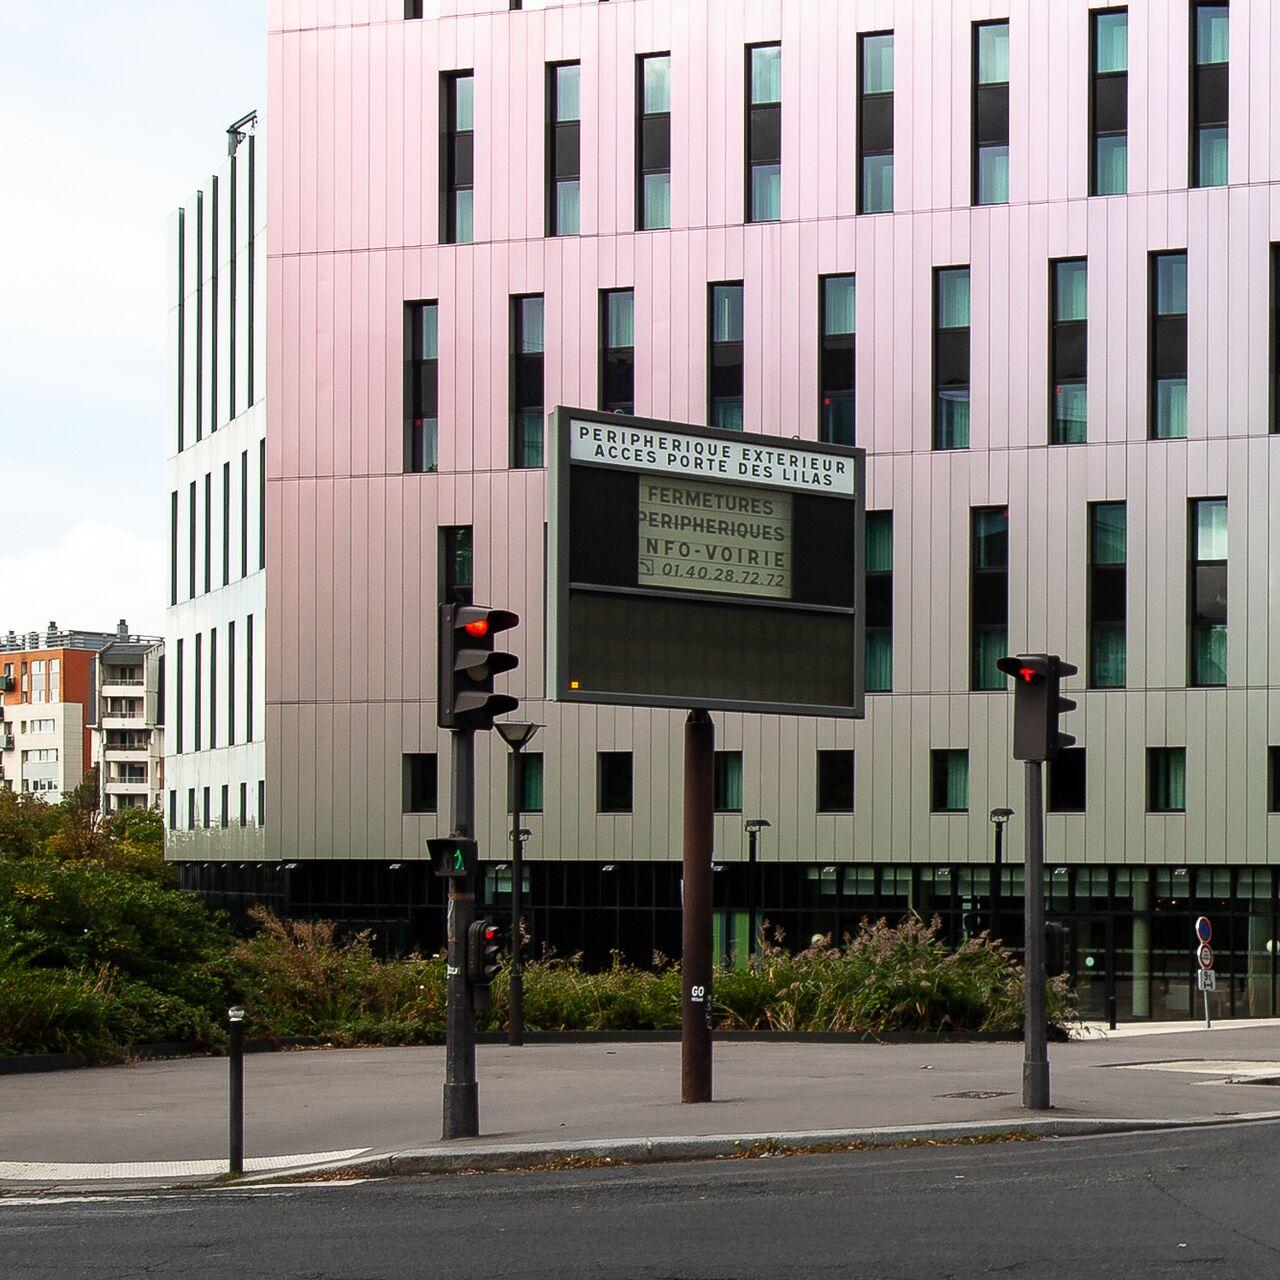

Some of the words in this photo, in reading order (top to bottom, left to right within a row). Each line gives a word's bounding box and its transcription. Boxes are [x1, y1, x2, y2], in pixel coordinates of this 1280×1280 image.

[579, 426, 731, 458] PERIPHERIQUE
[742, 448, 845, 474] EXTERIEUR
[594, 444, 657, 464] ACCES
[667, 453, 727, 473] PORTE
[738, 462, 773, 479] DES
[783, 468, 833, 486] LILAS
[648, 485, 774, 516] FERMETURES
[662, 562, 785, 588] 01.40.28.72.72
[691, 985, 704, 996] GO
